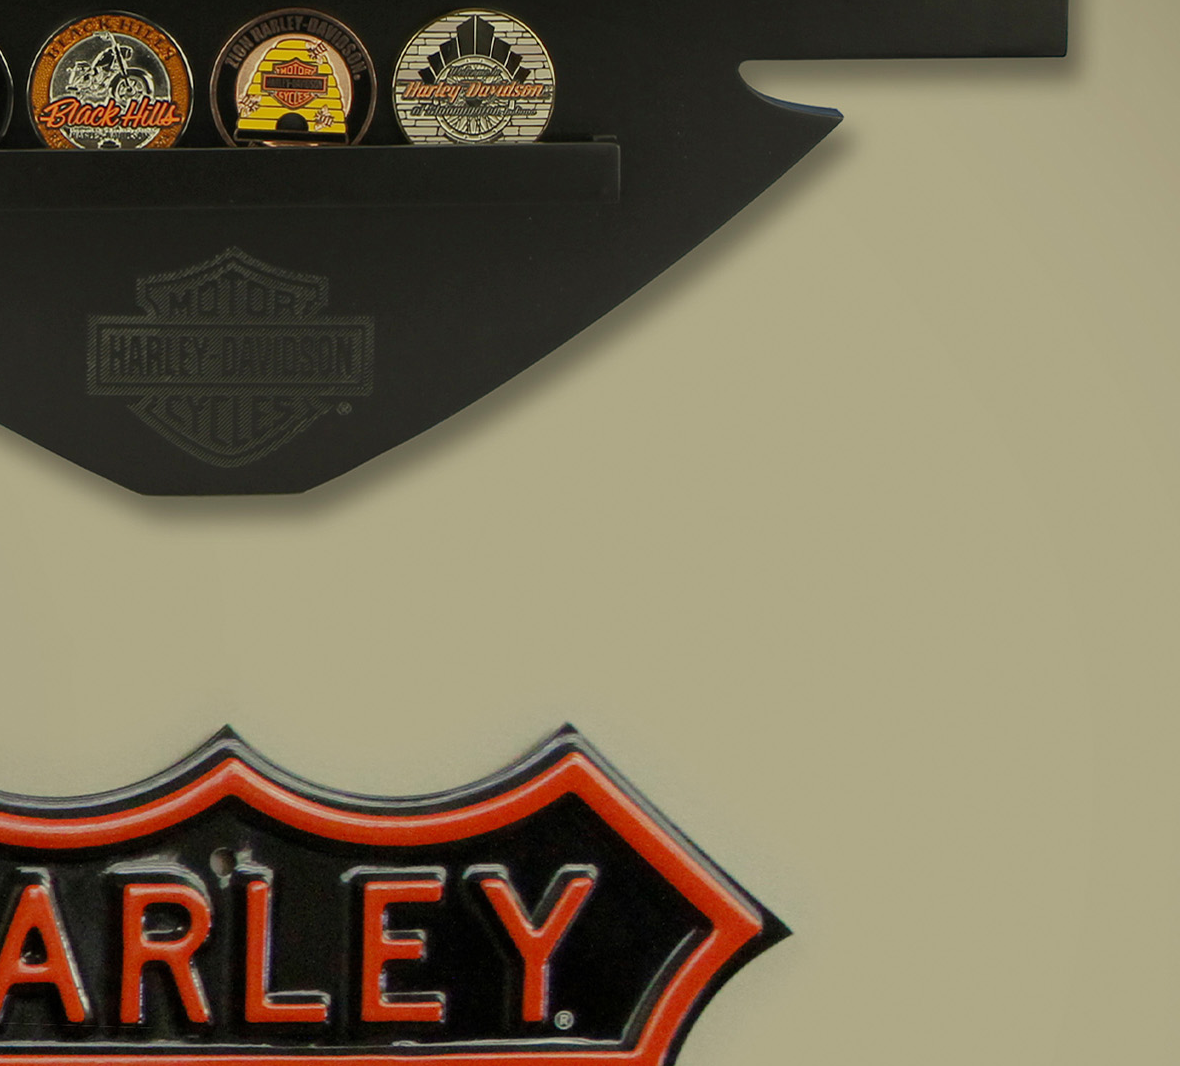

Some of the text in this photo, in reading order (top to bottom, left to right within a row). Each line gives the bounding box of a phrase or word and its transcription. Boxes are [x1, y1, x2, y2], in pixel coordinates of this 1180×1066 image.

[224, 35, 255, 70] ZION
[280, 66, 313, 76] MOTOR
[278, 91, 312, 106] CYCLES
[401, 79, 545, 104] Harley-Davidson
[39, 96, 181, 129] Black Hills
[168, 272, 298, 315] MOTOR
[108, 334, 352, 378] HARLEY-DAVIDSON
